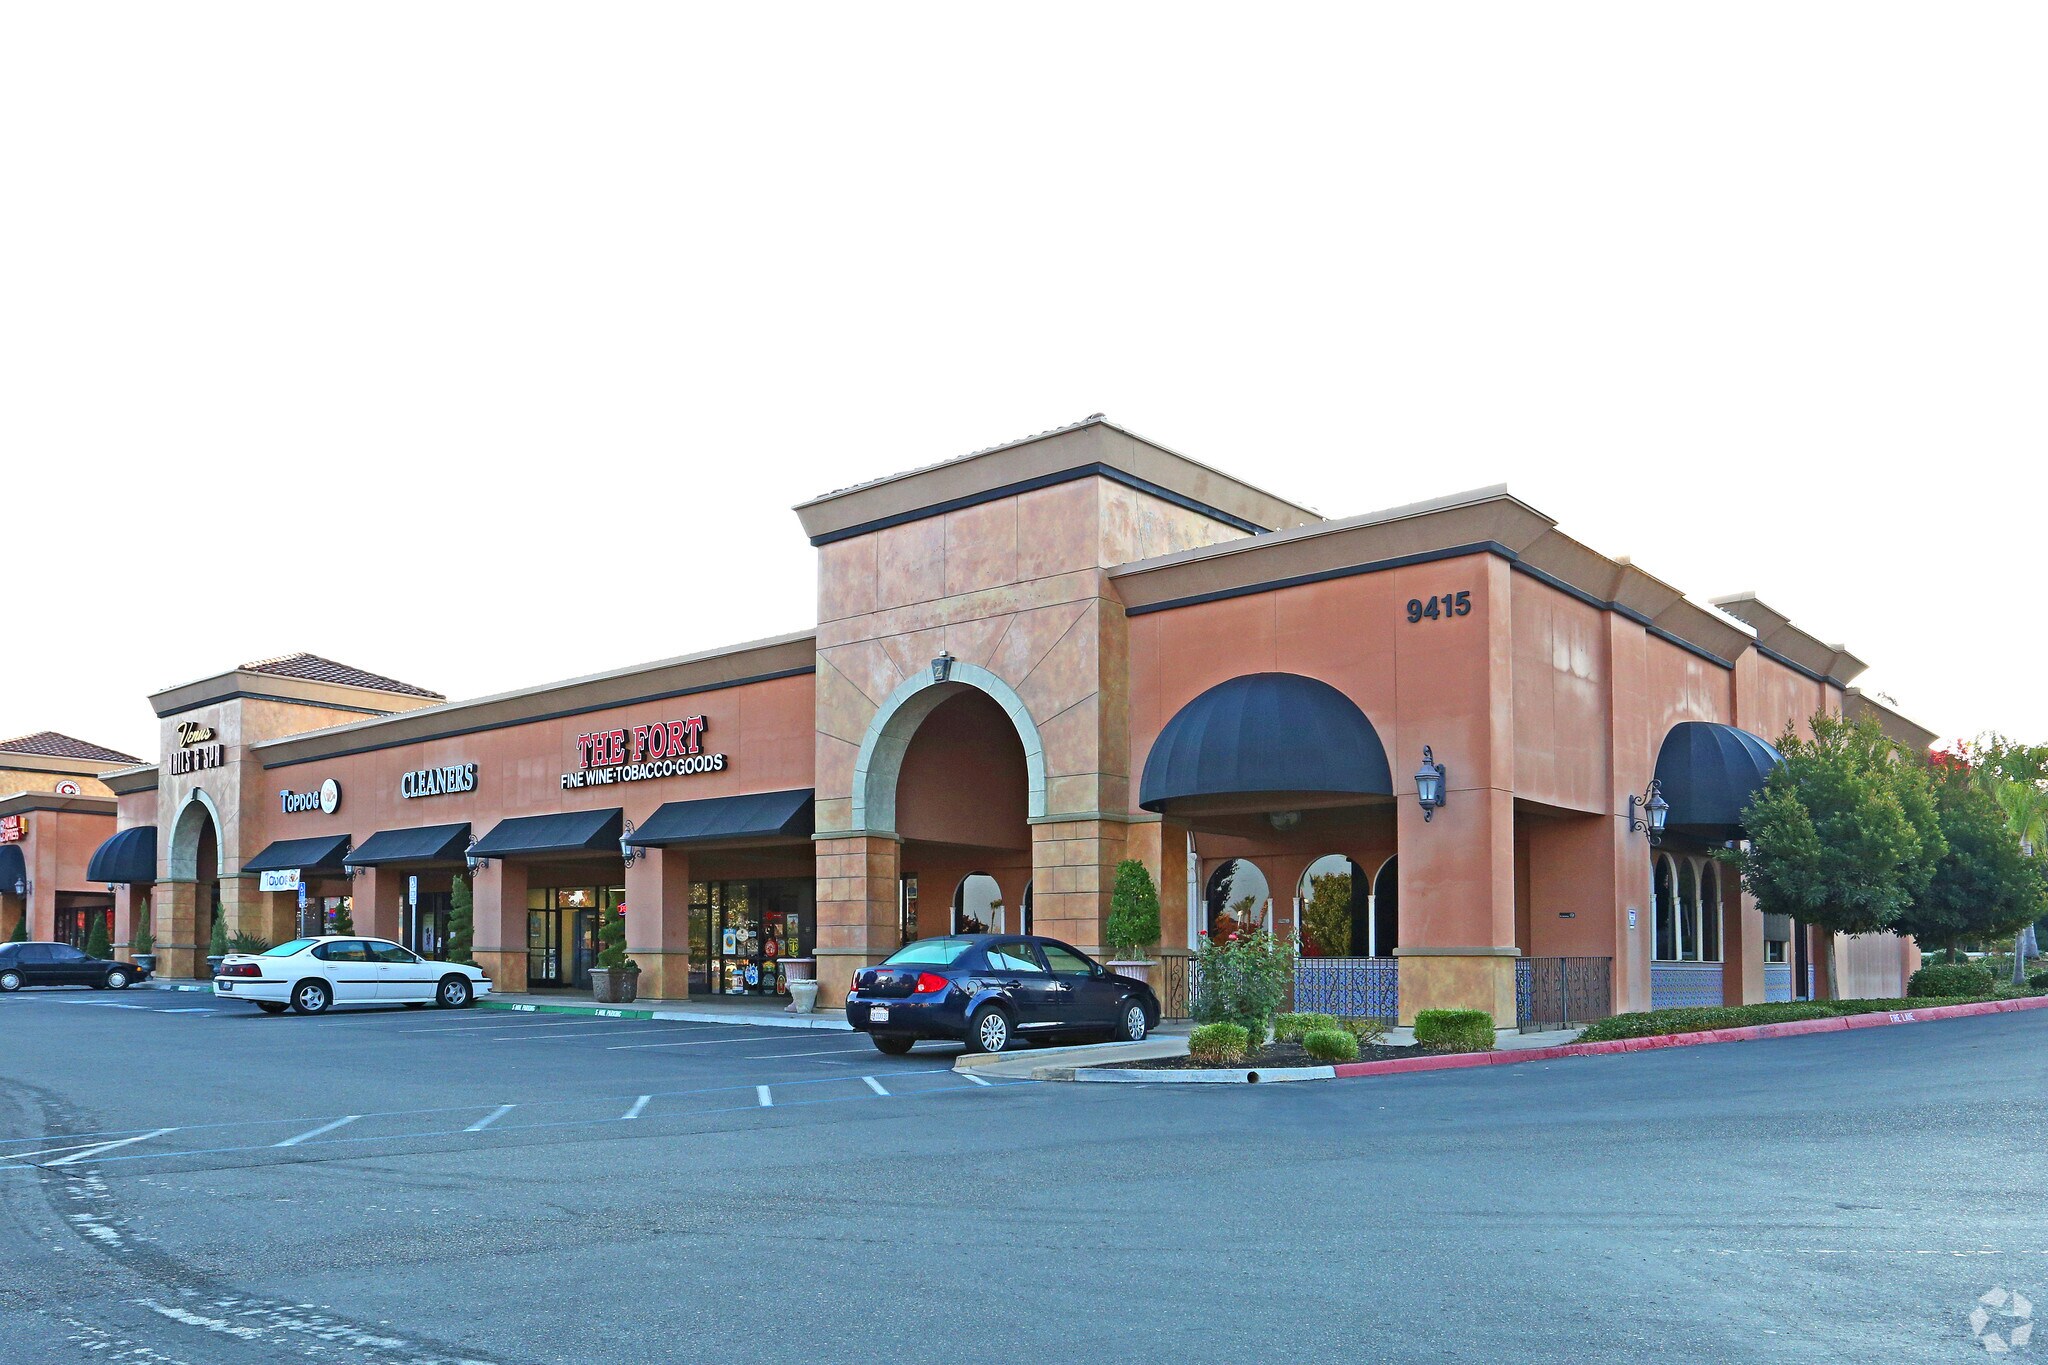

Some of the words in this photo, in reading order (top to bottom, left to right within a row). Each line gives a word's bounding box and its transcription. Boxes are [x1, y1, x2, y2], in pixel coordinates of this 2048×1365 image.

[1406, 591, 1471, 623] 9415
[203, 744, 220, 769] SPA
[576, 729, 628, 769] THE
[632, 715, 705, 762] FORT
[401, 763, 475, 799] CLEANERS
[561, 772, 584, 790] FINE
